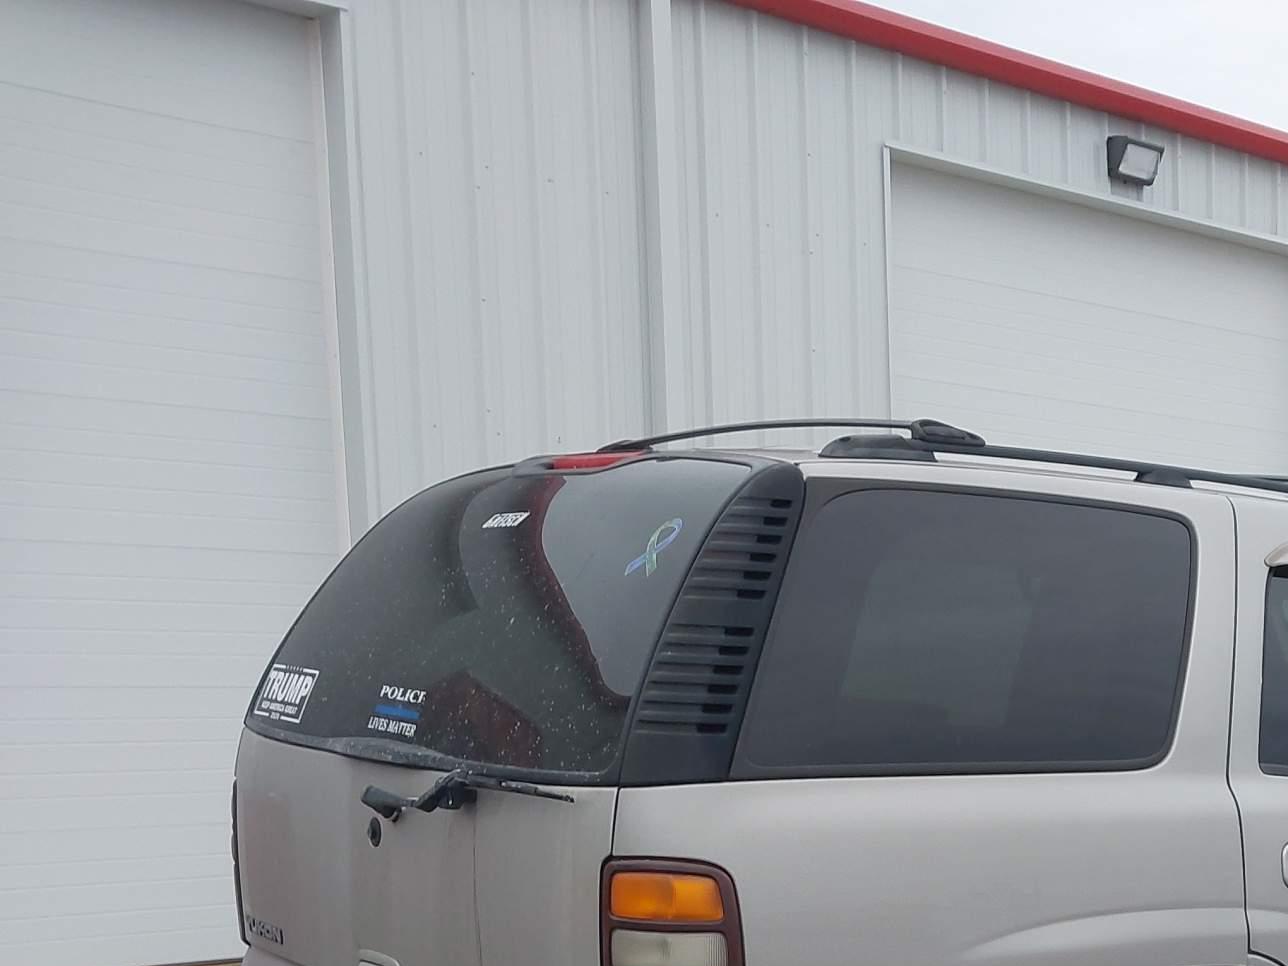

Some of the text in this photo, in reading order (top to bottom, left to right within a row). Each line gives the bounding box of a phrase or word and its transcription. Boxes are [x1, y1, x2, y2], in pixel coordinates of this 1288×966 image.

[263, 670, 313, 705] TRUMP
[367, 716, 417, 737] LIVES MATTER
